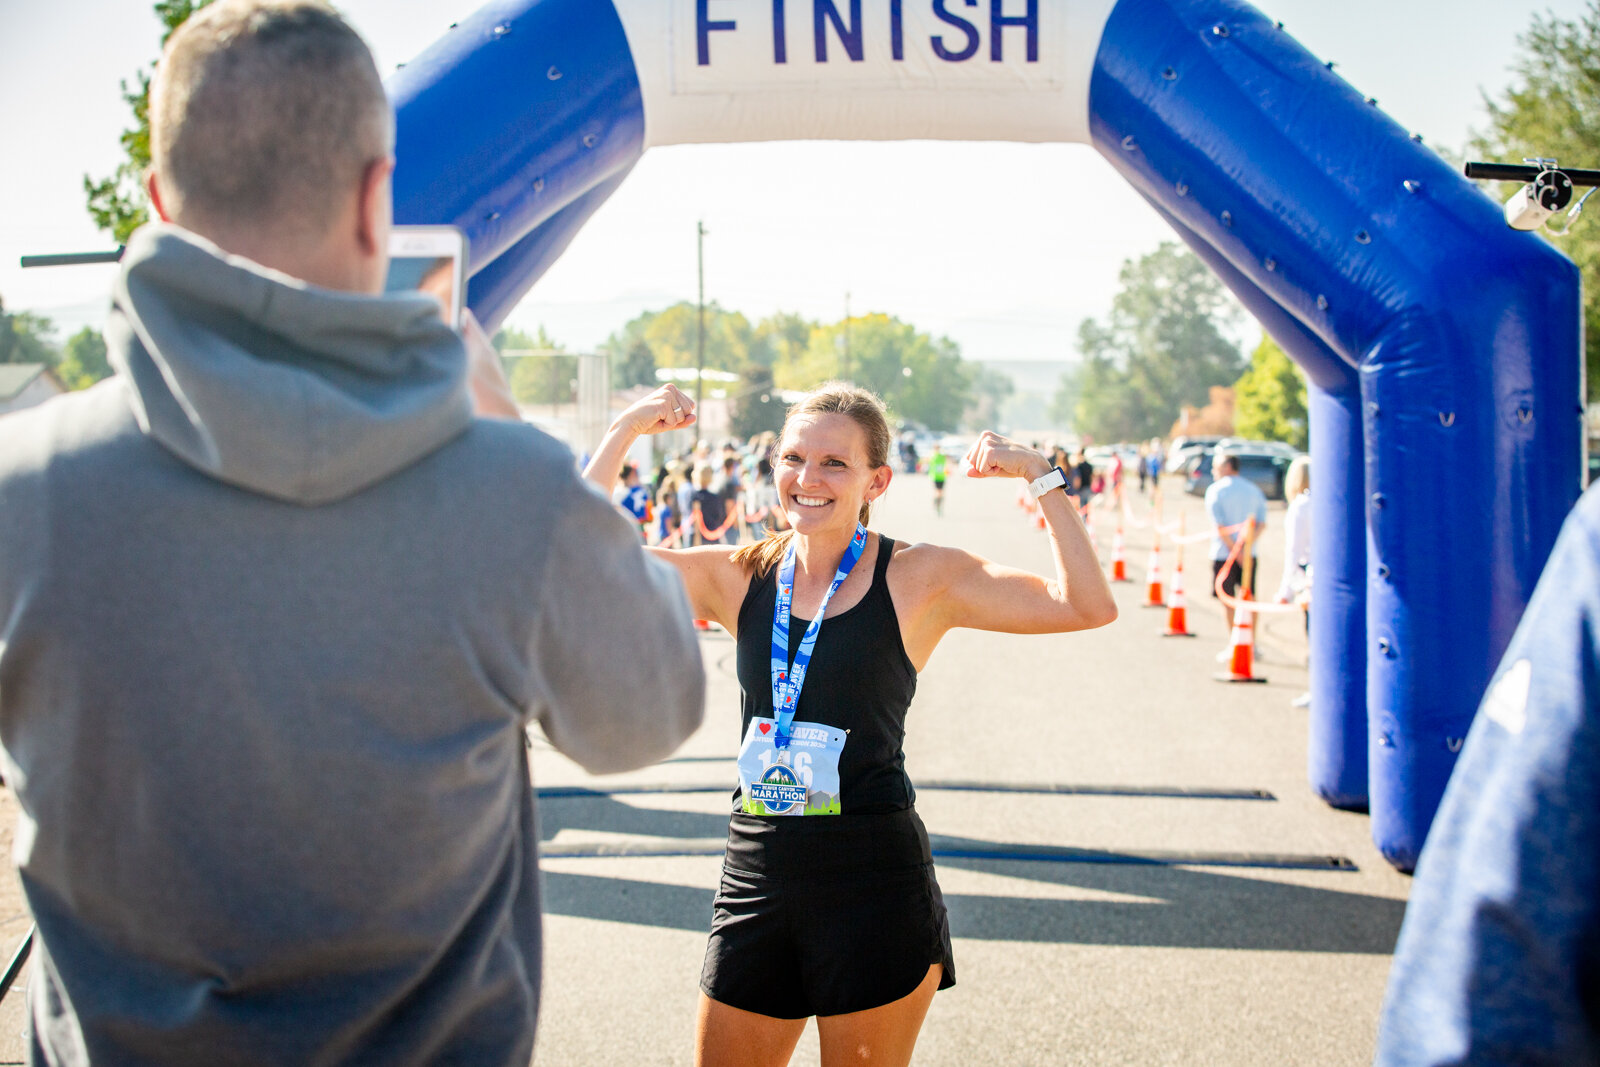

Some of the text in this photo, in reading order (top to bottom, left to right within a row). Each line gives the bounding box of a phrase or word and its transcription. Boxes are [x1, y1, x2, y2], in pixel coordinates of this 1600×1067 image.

[696, 0, 1038, 65] FINISH
[780, 596, 789, 624] BEAVER
[789, 663, 802, 693] BEAVER
[752, 789, 805, 800] MARATHON
